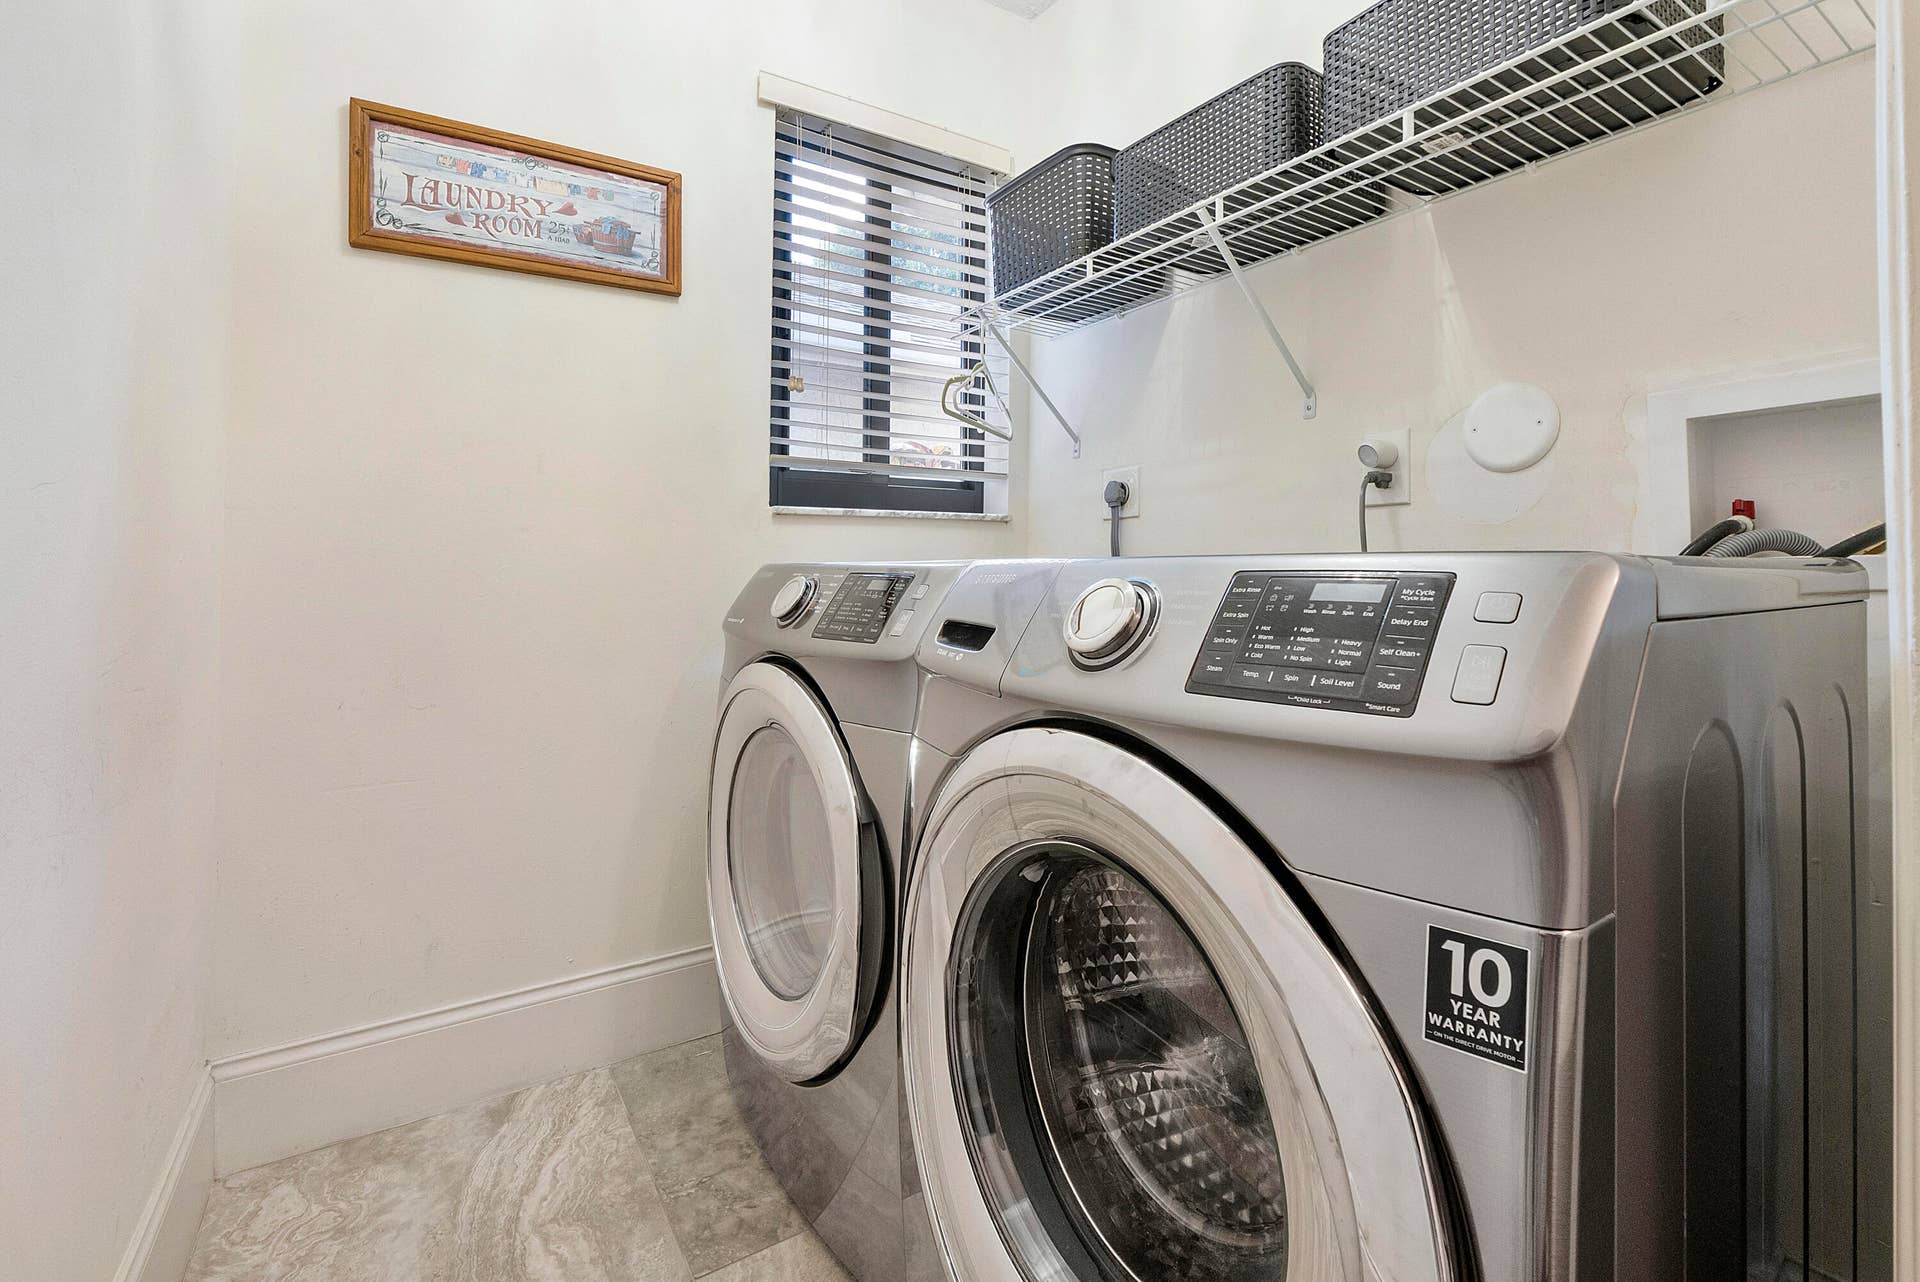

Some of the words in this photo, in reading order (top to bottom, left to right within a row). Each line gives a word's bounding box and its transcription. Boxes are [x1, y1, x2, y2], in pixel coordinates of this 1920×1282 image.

[400, 171, 554, 217] LAUNDRY
[471, 212, 543, 239] ROOM
[1402, 588, 1416, 596] My
[1415, 589, 1436, 597] Cycle
[1390, 618, 1412, 627] Delay
[1413, 618, 1429, 626] End
[1225, 637, 1238, 645] Only
[1341, 639, 1362, 648] Heavy
[1338, 649, 1362, 657] Normal
[1379, 648, 1396, 656] Self
[1300, 655, 1313, 663] Spin
[1334, 659, 1352, 667] Light
[1284, 674, 1299, 682] Spin
[1320, 677, 1334, 685] Soil
[1334, 679, 1355, 688] Level
[1377, 681, 1401, 690] Sound
[1441, 939, 1512, 1008] 10
[1450, 998, 1501, 1029] YEAR
[1428, 1011, 1524, 1052] WARRANTY
[1444, 1033, 1455, 1041] THE
[1455, 1037, 1475, 1048] DIRECT
[1476, 1044, 1493, 1054] DRIVE
[1494, 1050, 1516, 1061] MOTOR
